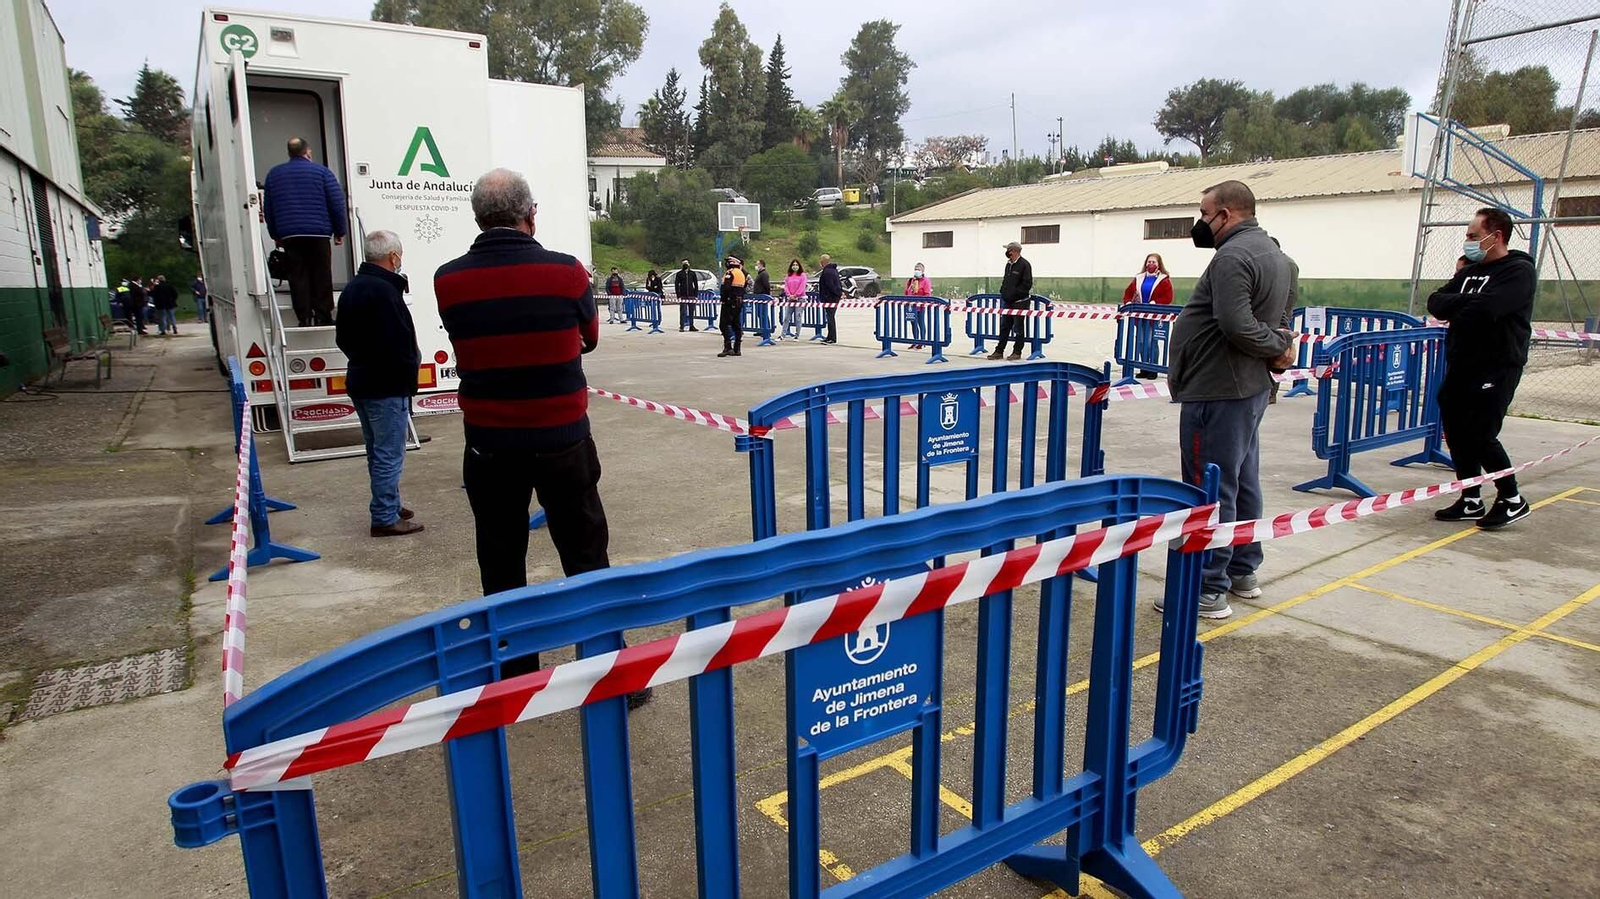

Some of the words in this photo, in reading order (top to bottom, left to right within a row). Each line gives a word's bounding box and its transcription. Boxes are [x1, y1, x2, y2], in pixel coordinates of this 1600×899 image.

[224, 33, 256, 51] C2
[369, 179, 403, 190] Junta
[406, 180, 420, 190] de
[423, 193, 440, 201] Salud
[446, 194, 470, 202] Familias
[422, 398, 458, 406] PROCHA
[294, 407, 349, 416] PROCHASIS
[928, 432, 969, 443] Ayuntamiento
[942, 440, 964, 448] Jimena
[943, 446, 969, 454] Frontera
[812, 662, 918, 703] Ayuntamiento
[825, 701, 846, 714] de
[850, 682, 905, 707] Jimena
[810, 721, 831, 735] de
[835, 716, 849, 727] la
[853, 694, 918, 722] Frontera
